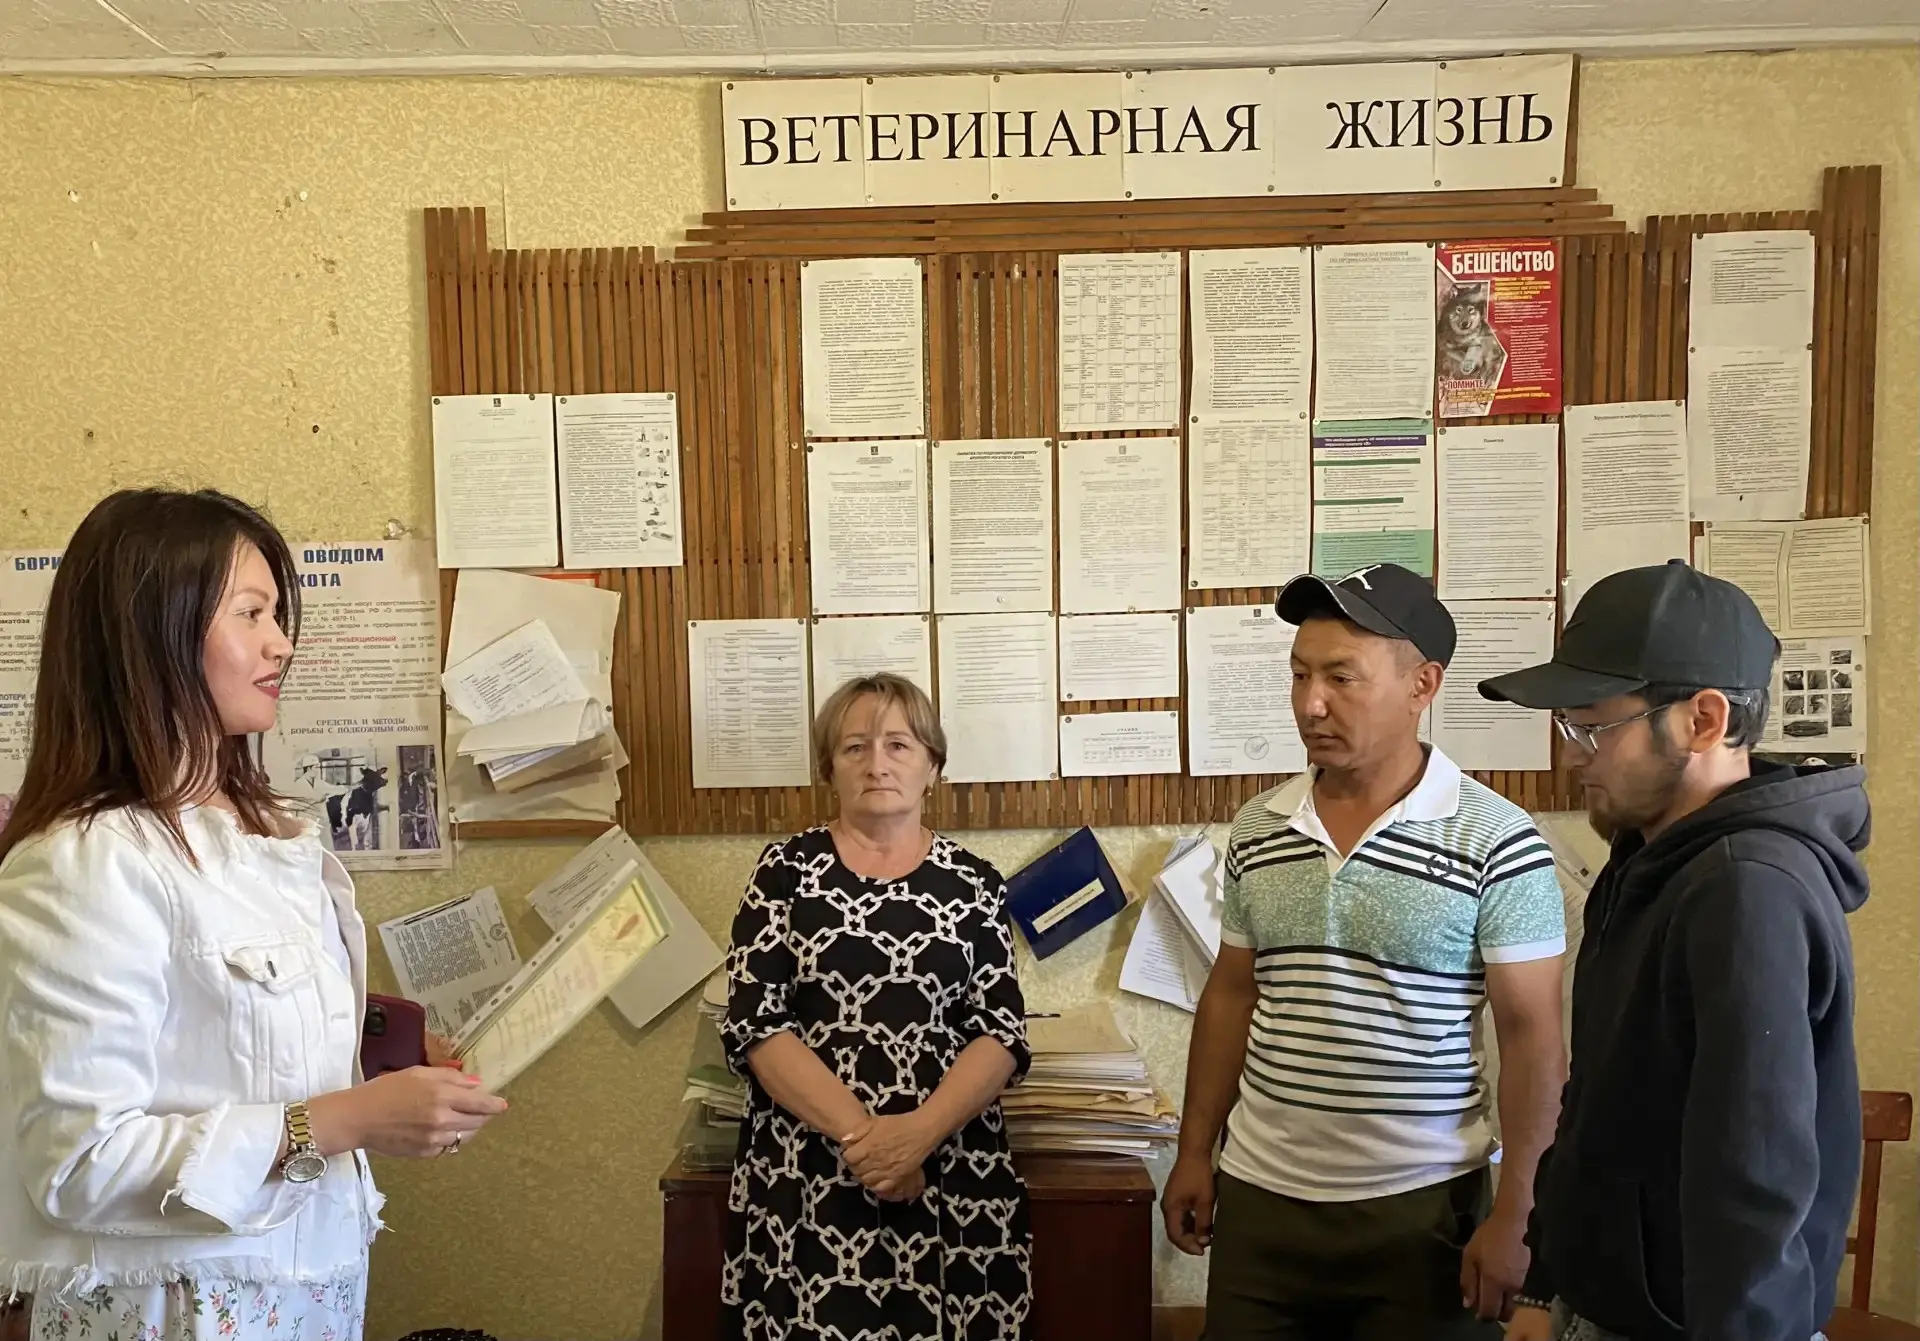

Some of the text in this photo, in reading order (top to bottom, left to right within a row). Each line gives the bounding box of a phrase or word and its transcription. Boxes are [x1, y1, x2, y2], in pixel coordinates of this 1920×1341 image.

[738, 92, 1554, 166] ВЕТЕРИНАРНАЯ ЖИЗНЬ
[1451, 250, 1555, 275] БЕШЕНСТВО
[303, 547, 384, 565] ОВОДОМ
[290, 727, 324, 735] БОРЬБЫ
[337, 725, 394, 734] ПОДКОЖНЫМ
[316, 717, 406, 727] СРЕДСТВА И МЕТОДЫ
